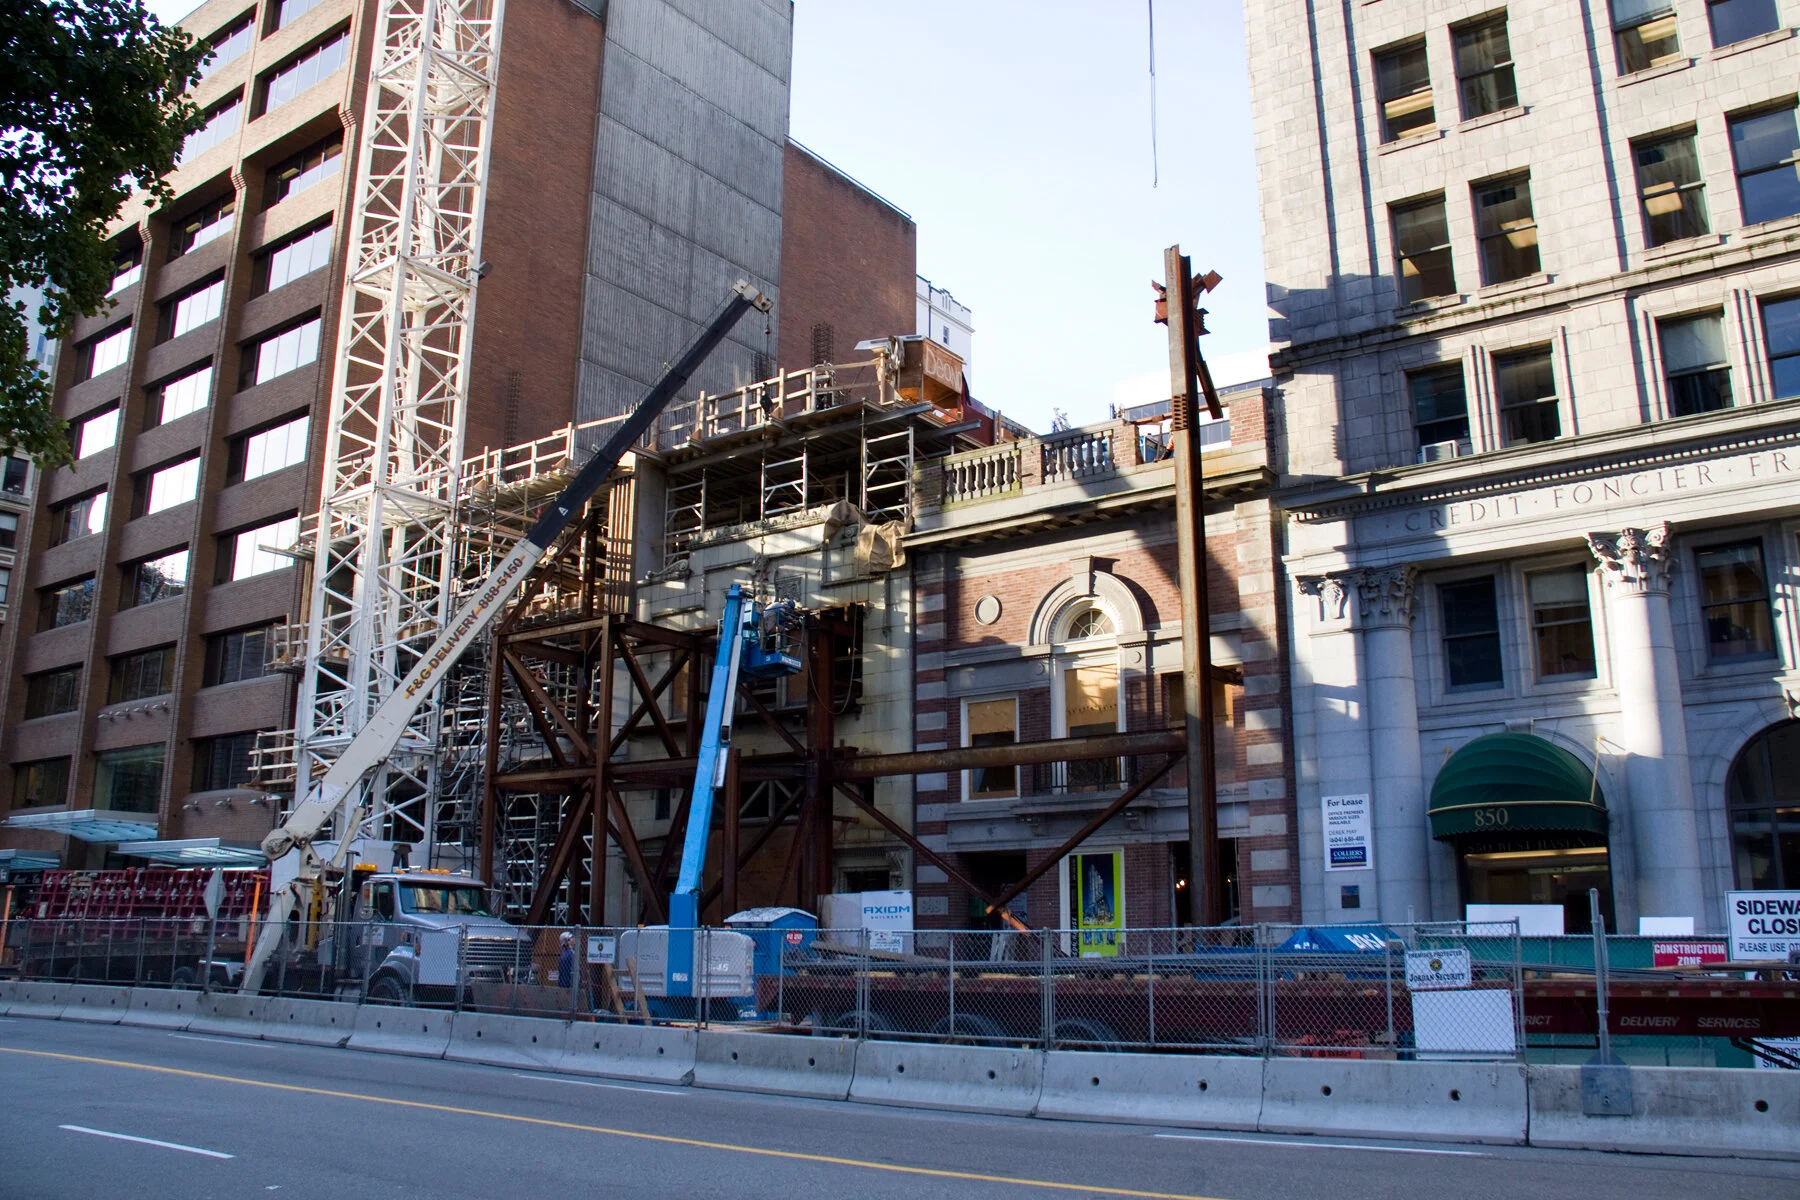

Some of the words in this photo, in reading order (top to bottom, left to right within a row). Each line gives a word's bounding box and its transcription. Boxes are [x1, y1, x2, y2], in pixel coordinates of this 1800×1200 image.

[1405, 496, 1522, 531] CREDIT
[1552, 464, 1716, 509] FONCIER
[1750, 451, 1800, 476] FR
[428, 610, 480, 670] DELIVERY
[477, 557, 524, 611] 888-5150
[1327, 799, 1340, 807] For
[1341, 798, 1363, 806] Lease
[1474, 808, 1509, 827] 850
[1333, 849, 1364, 857] COLLIERS
[863, 905, 910, 915] AXIOM
[1748, 919, 1800, 934] CLOS
[1654, 944, 1725, 954] CONSTRUCTION
[1739, 942, 1768, 953] PLEASE
[1770, 943, 1786, 953] USE
[1788, 943, 1800, 953] OT
[1677, 956, 1702, 966] ZONE
[1620, 1015, 1680, 1027] DELIVERY
[1697, 1016, 1761, 1029] SERVICES
